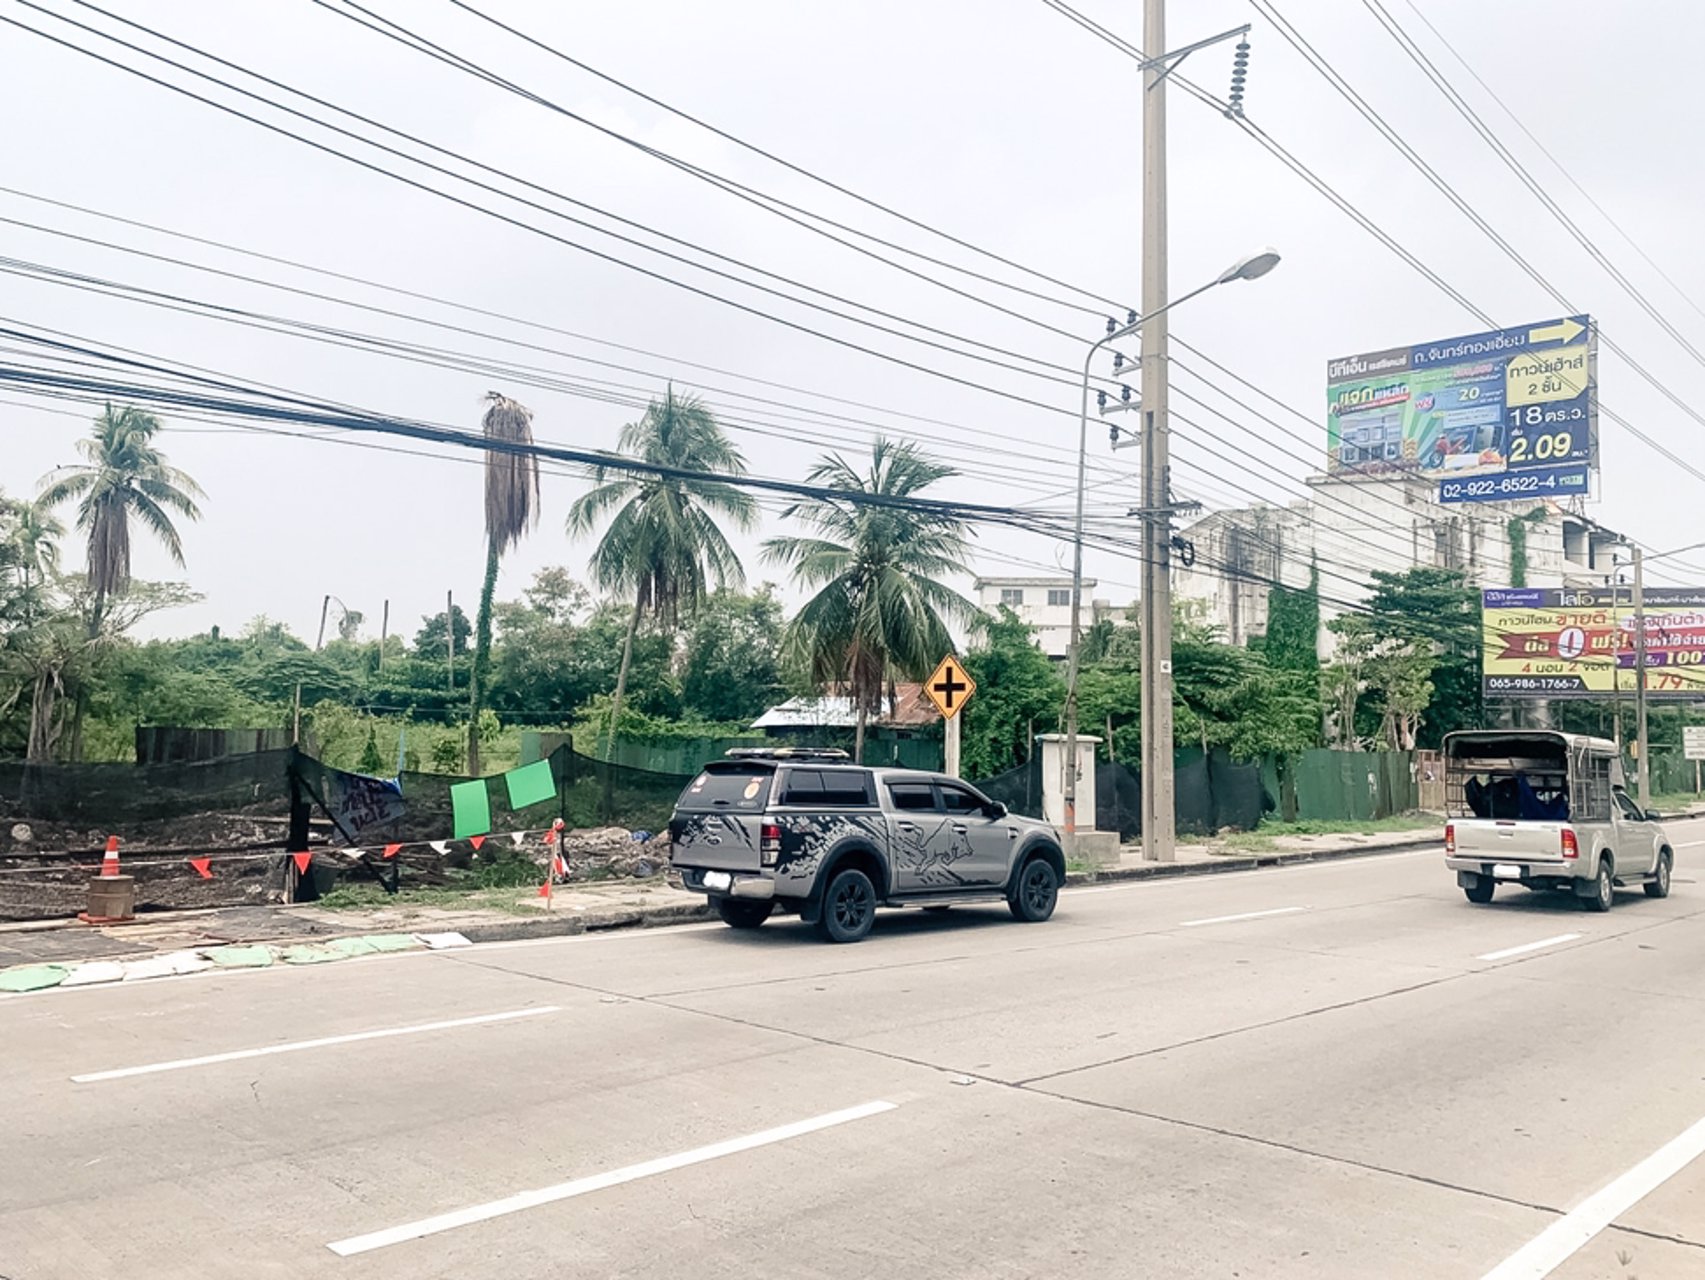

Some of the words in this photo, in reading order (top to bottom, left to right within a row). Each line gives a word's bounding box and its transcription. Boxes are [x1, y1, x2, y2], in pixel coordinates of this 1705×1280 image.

[1458, 386, 1480, 402] 20
[1528, 384, 1538, 396] 2
[1542, 375, 1562, 393] ชั้น
[1510, 406, 1543, 426] 18
[1544, 408, 1586, 423] ตร.ว.
[1509, 432, 1573, 463] 2.09
[1443, 475, 1556, 498] 02-922-6522-4
[1556, 609, 1608, 626] ขายดี
[1666, 651, 1705, 665] 100
[1521, 662, 1531, 673] 4
[1536, 663, 1564, 673] นอน
[1568, 662, 1577, 672] 2
[1489, 678, 1580, 689] 065-986-1766-7
